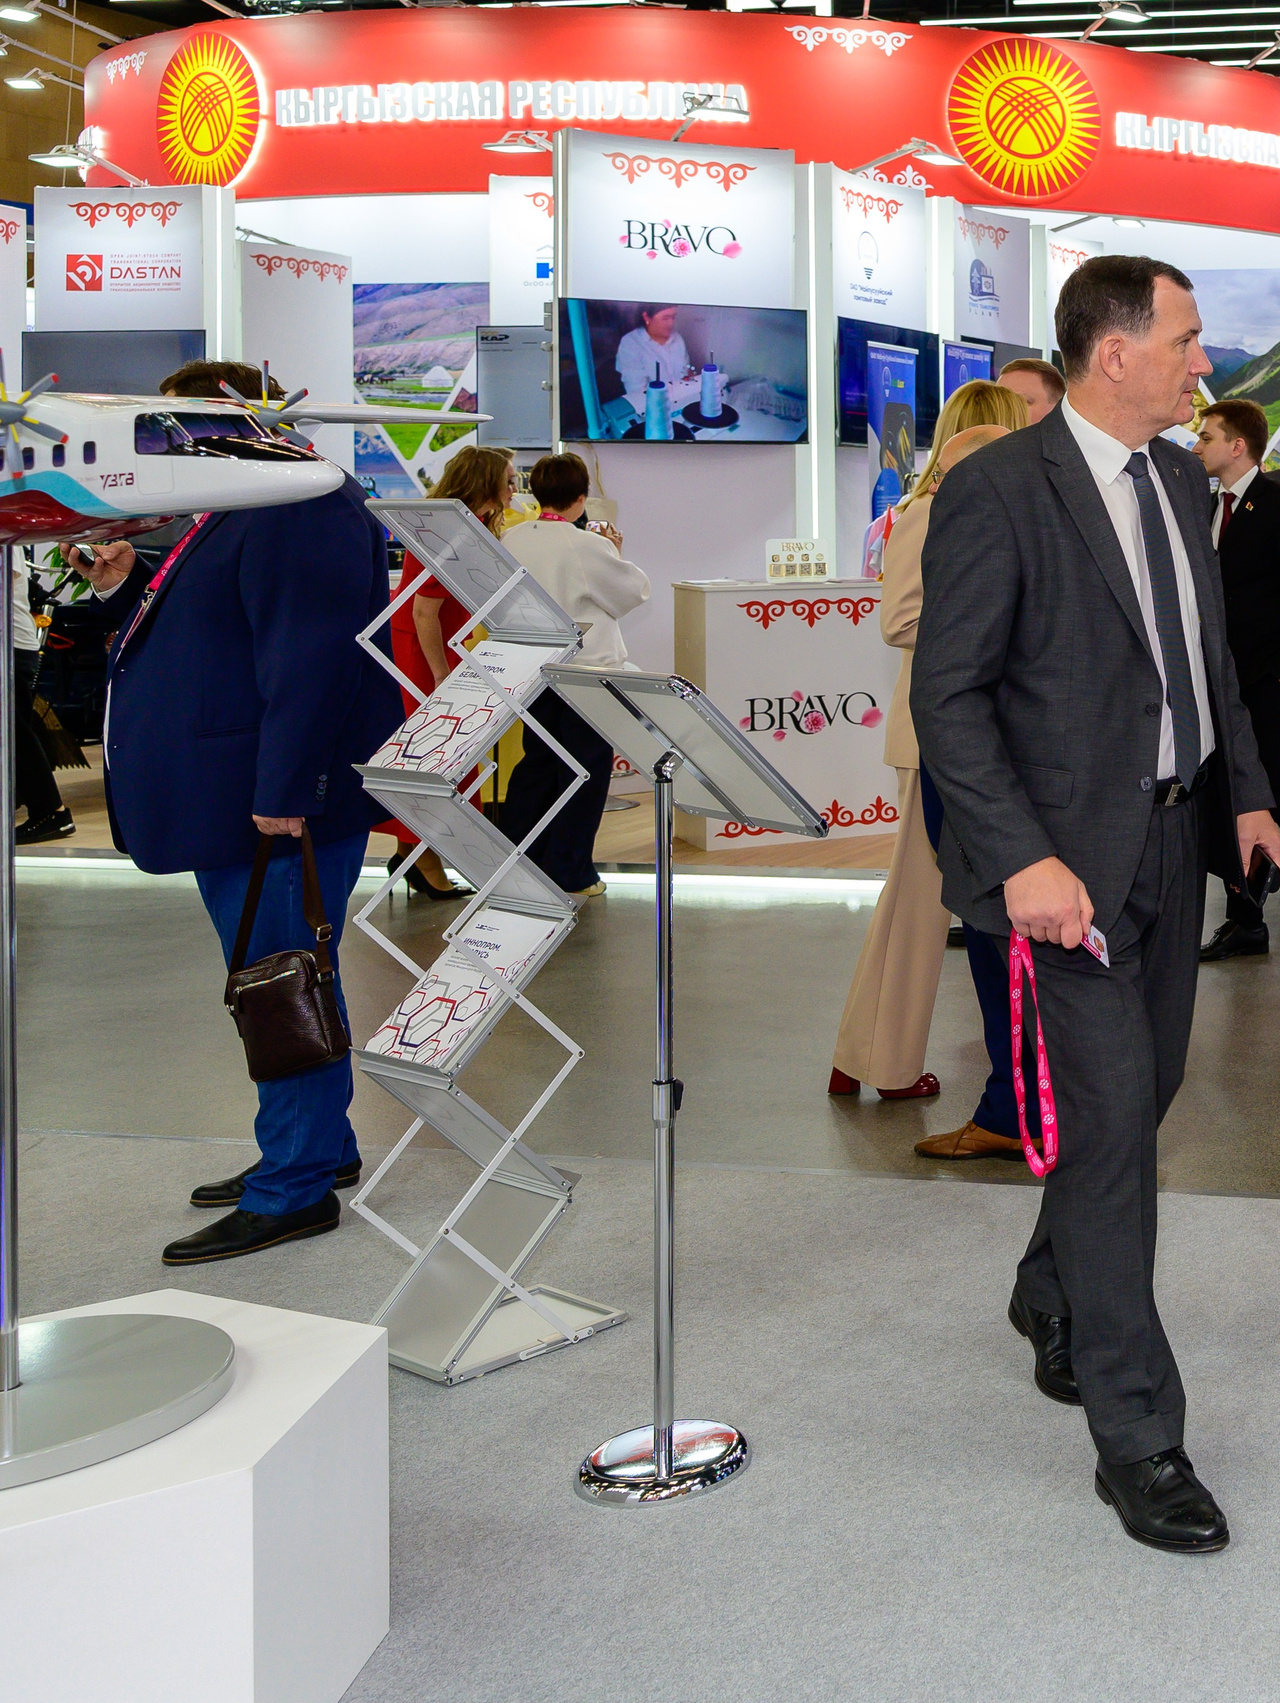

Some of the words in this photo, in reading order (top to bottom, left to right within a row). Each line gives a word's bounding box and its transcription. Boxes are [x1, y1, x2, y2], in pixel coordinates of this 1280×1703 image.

[276, 81, 501, 126] КЫРГЫЗСКАЯ
[622, 219, 738, 258] BRAVO
[110, 266, 181, 279] DASTAN
[782, 542, 815, 553] BRAVO
[745, 691, 878, 735] BRAVO
